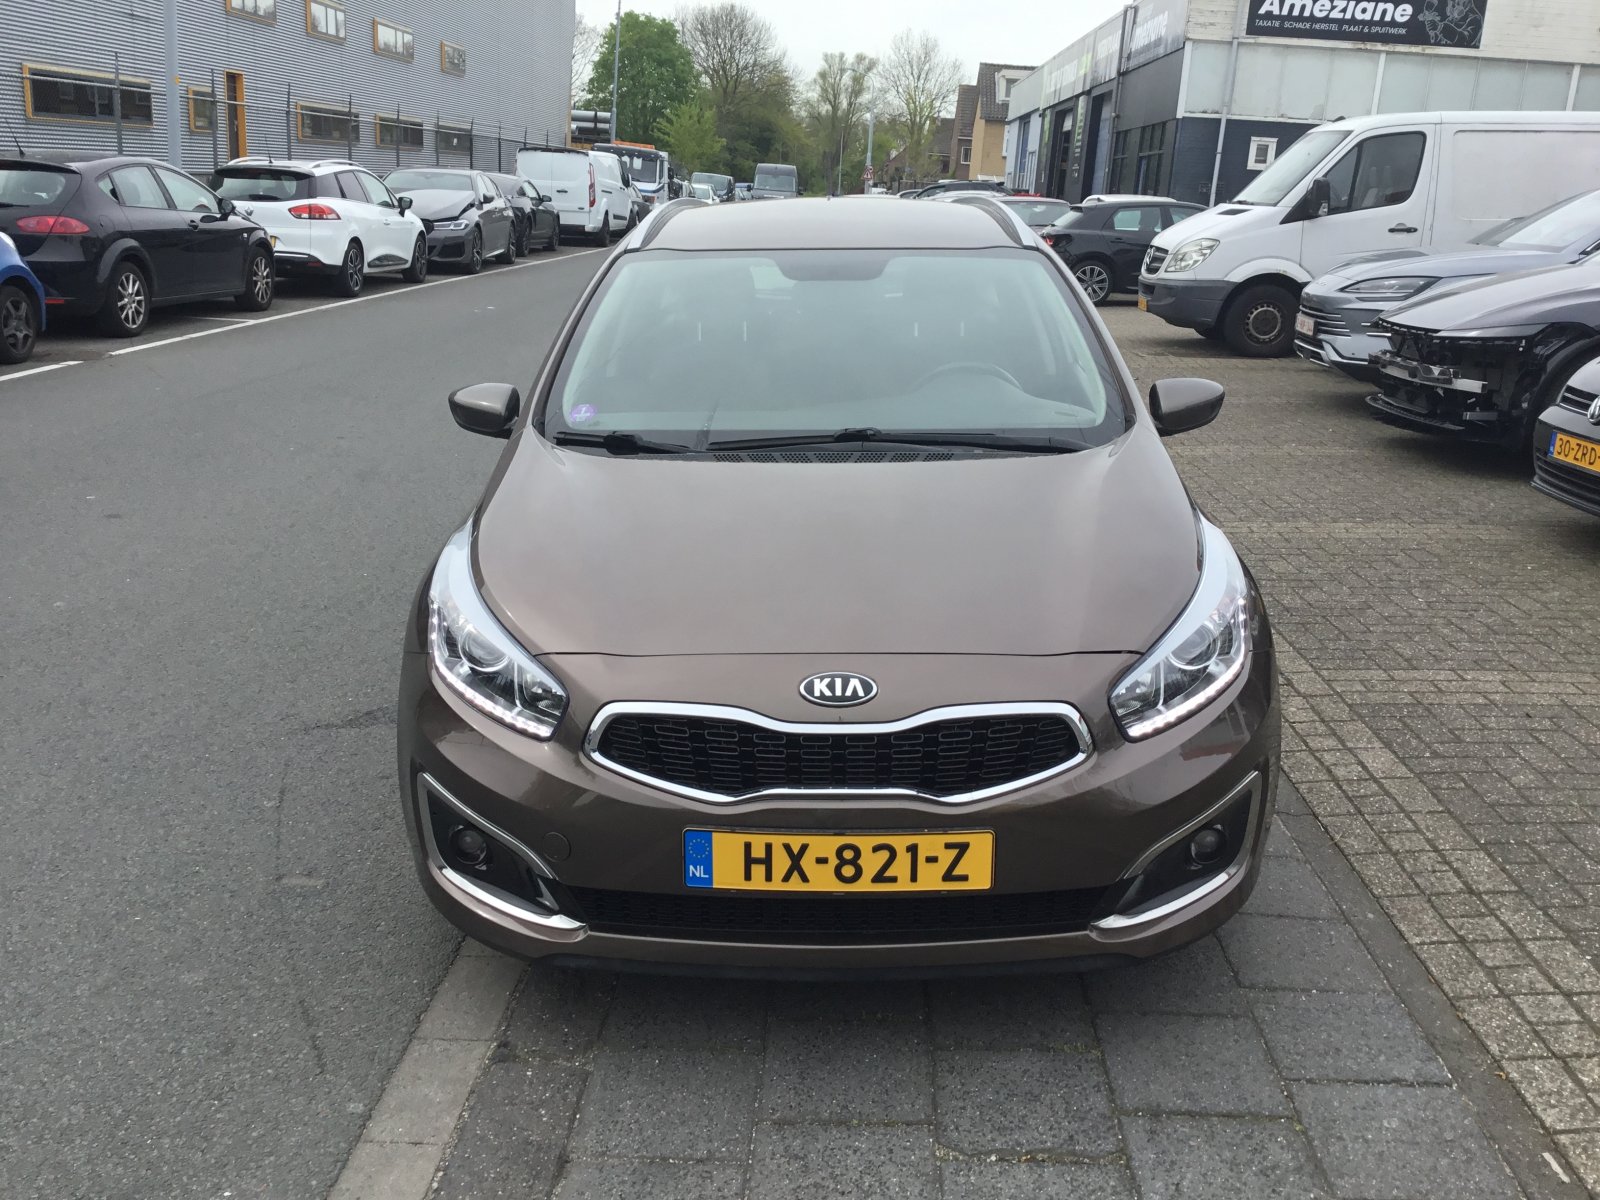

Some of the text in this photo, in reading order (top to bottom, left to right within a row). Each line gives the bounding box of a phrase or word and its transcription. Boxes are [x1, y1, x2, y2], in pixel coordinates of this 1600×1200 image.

[1258, 0, 1413, 22] Ameziane
[1255, 19, 1408, 35] TAXATIE SCHADE HERSTEL PLAAT & SPUITWERK
[813, 677, 865, 697] KIA
[689, 864, 710, 878] NL
[743, 841, 971, 884] HX-821-Z
